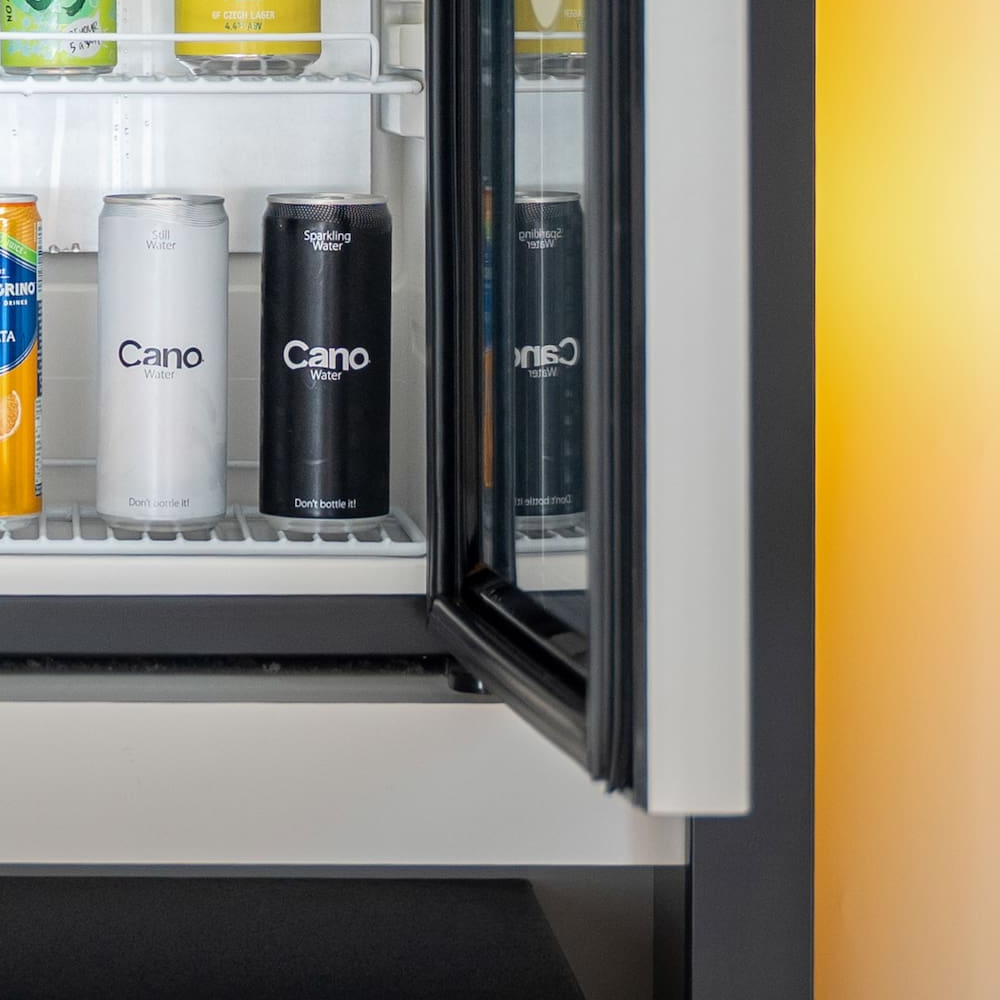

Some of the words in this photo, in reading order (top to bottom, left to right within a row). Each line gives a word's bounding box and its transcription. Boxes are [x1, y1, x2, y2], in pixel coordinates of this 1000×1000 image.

[5, 5, 13, 22] NO
[151, 230, 170, 240] Still
[303, 230, 351, 243] Sparkling
[146, 240, 176, 250] Water
[311, 241, 343, 251] Water
[118, 339, 203, 369] Cano
[283, 339, 370, 371] Cano
[144, 369, 174, 379] Water
[310, 369, 342, 381] Water
[128, 496, 151, 507] Don't
[294, 497, 318, 509] Don't
[319, 498, 347, 509] bottle
[347, 498, 357, 509] it!
